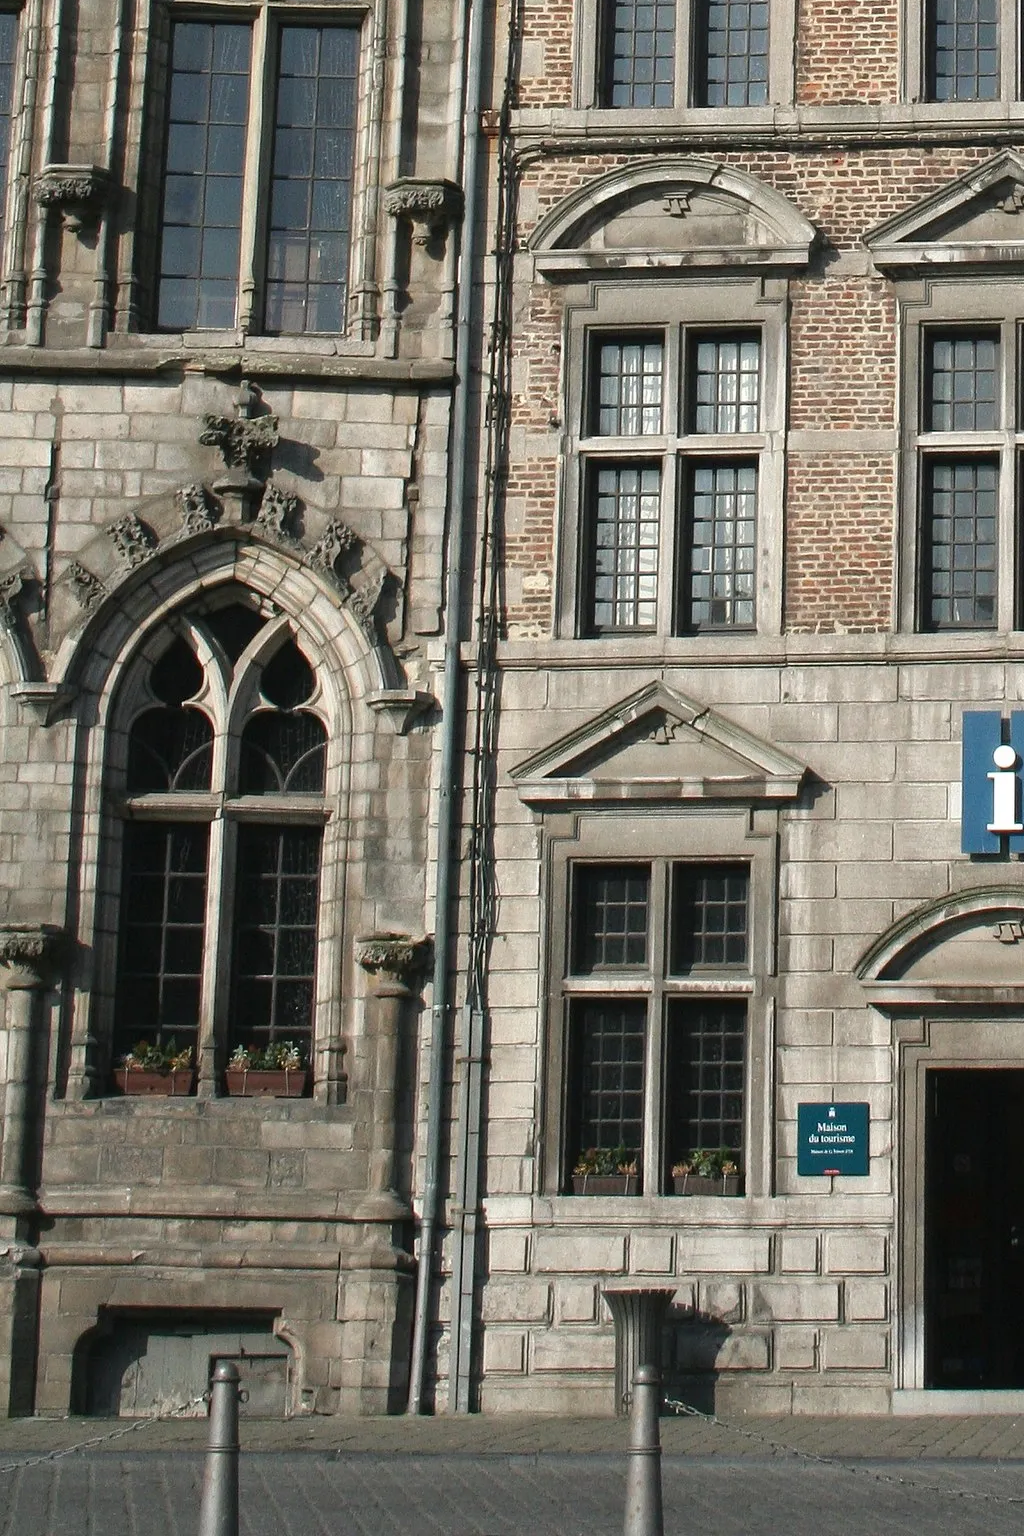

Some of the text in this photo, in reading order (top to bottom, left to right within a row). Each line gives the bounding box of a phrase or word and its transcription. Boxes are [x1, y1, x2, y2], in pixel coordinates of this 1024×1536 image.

[817, 1122, 847, 1132] Maison
[808, 1133, 856, 1143] du tourisme
